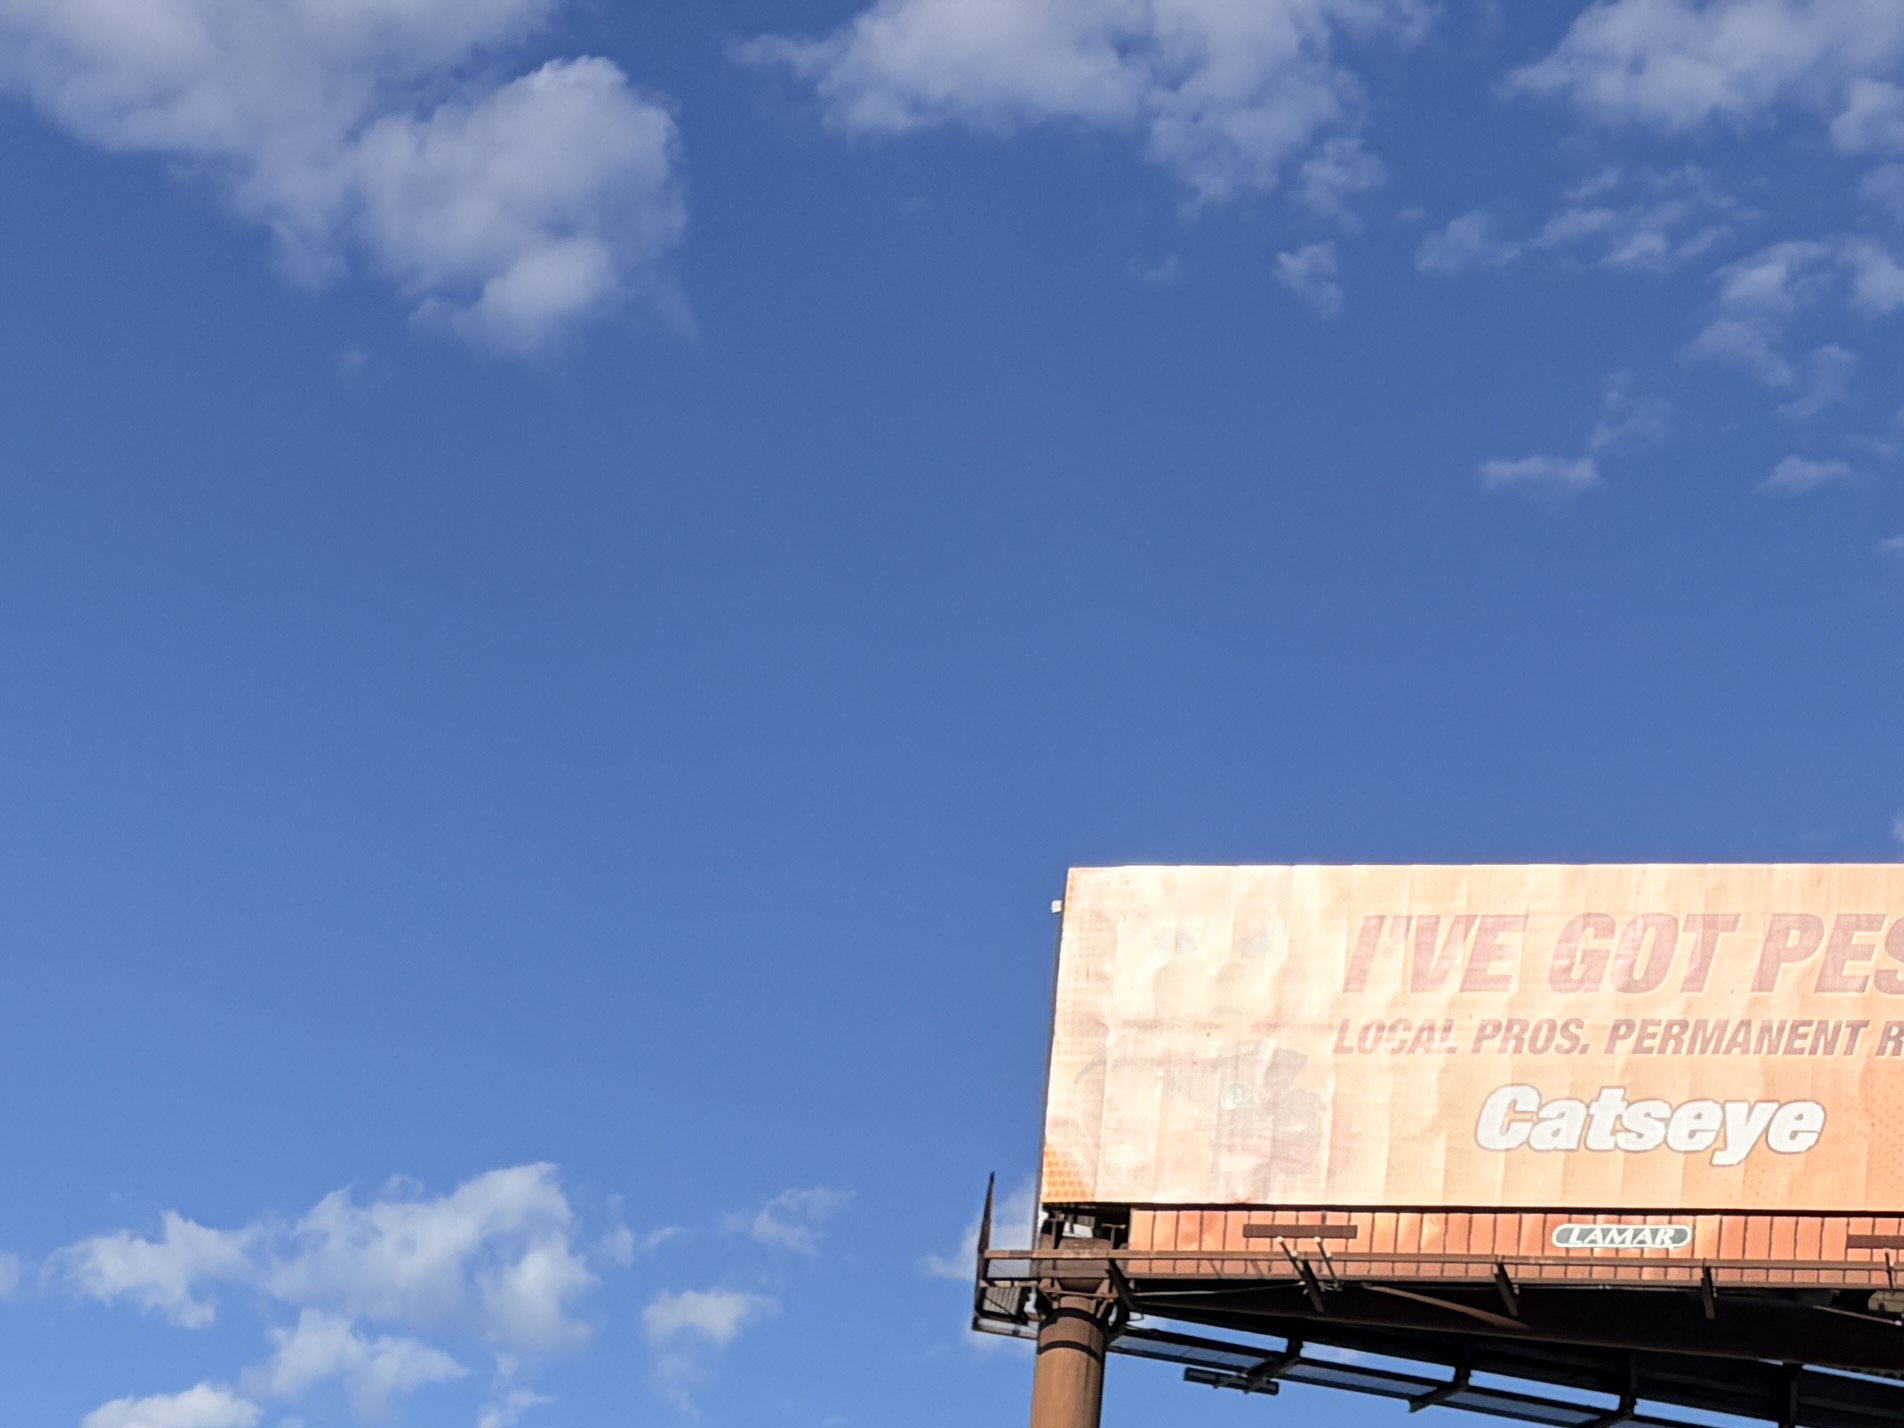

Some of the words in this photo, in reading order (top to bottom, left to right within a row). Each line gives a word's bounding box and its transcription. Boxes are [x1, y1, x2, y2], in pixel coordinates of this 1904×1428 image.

[1341, 912, 1530, 994] I'VE
[1547, 911, 1741, 995] GOT
[1332, 1017, 1458, 1055] LOCAL
[1470, 1017, 1591, 1056] PROS.
[1603, 1018, 1870, 1057] PERMANENT
[1474, 1083, 1827, 1167] Catseye
[1568, 1227, 1676, 1246] LAMAR
